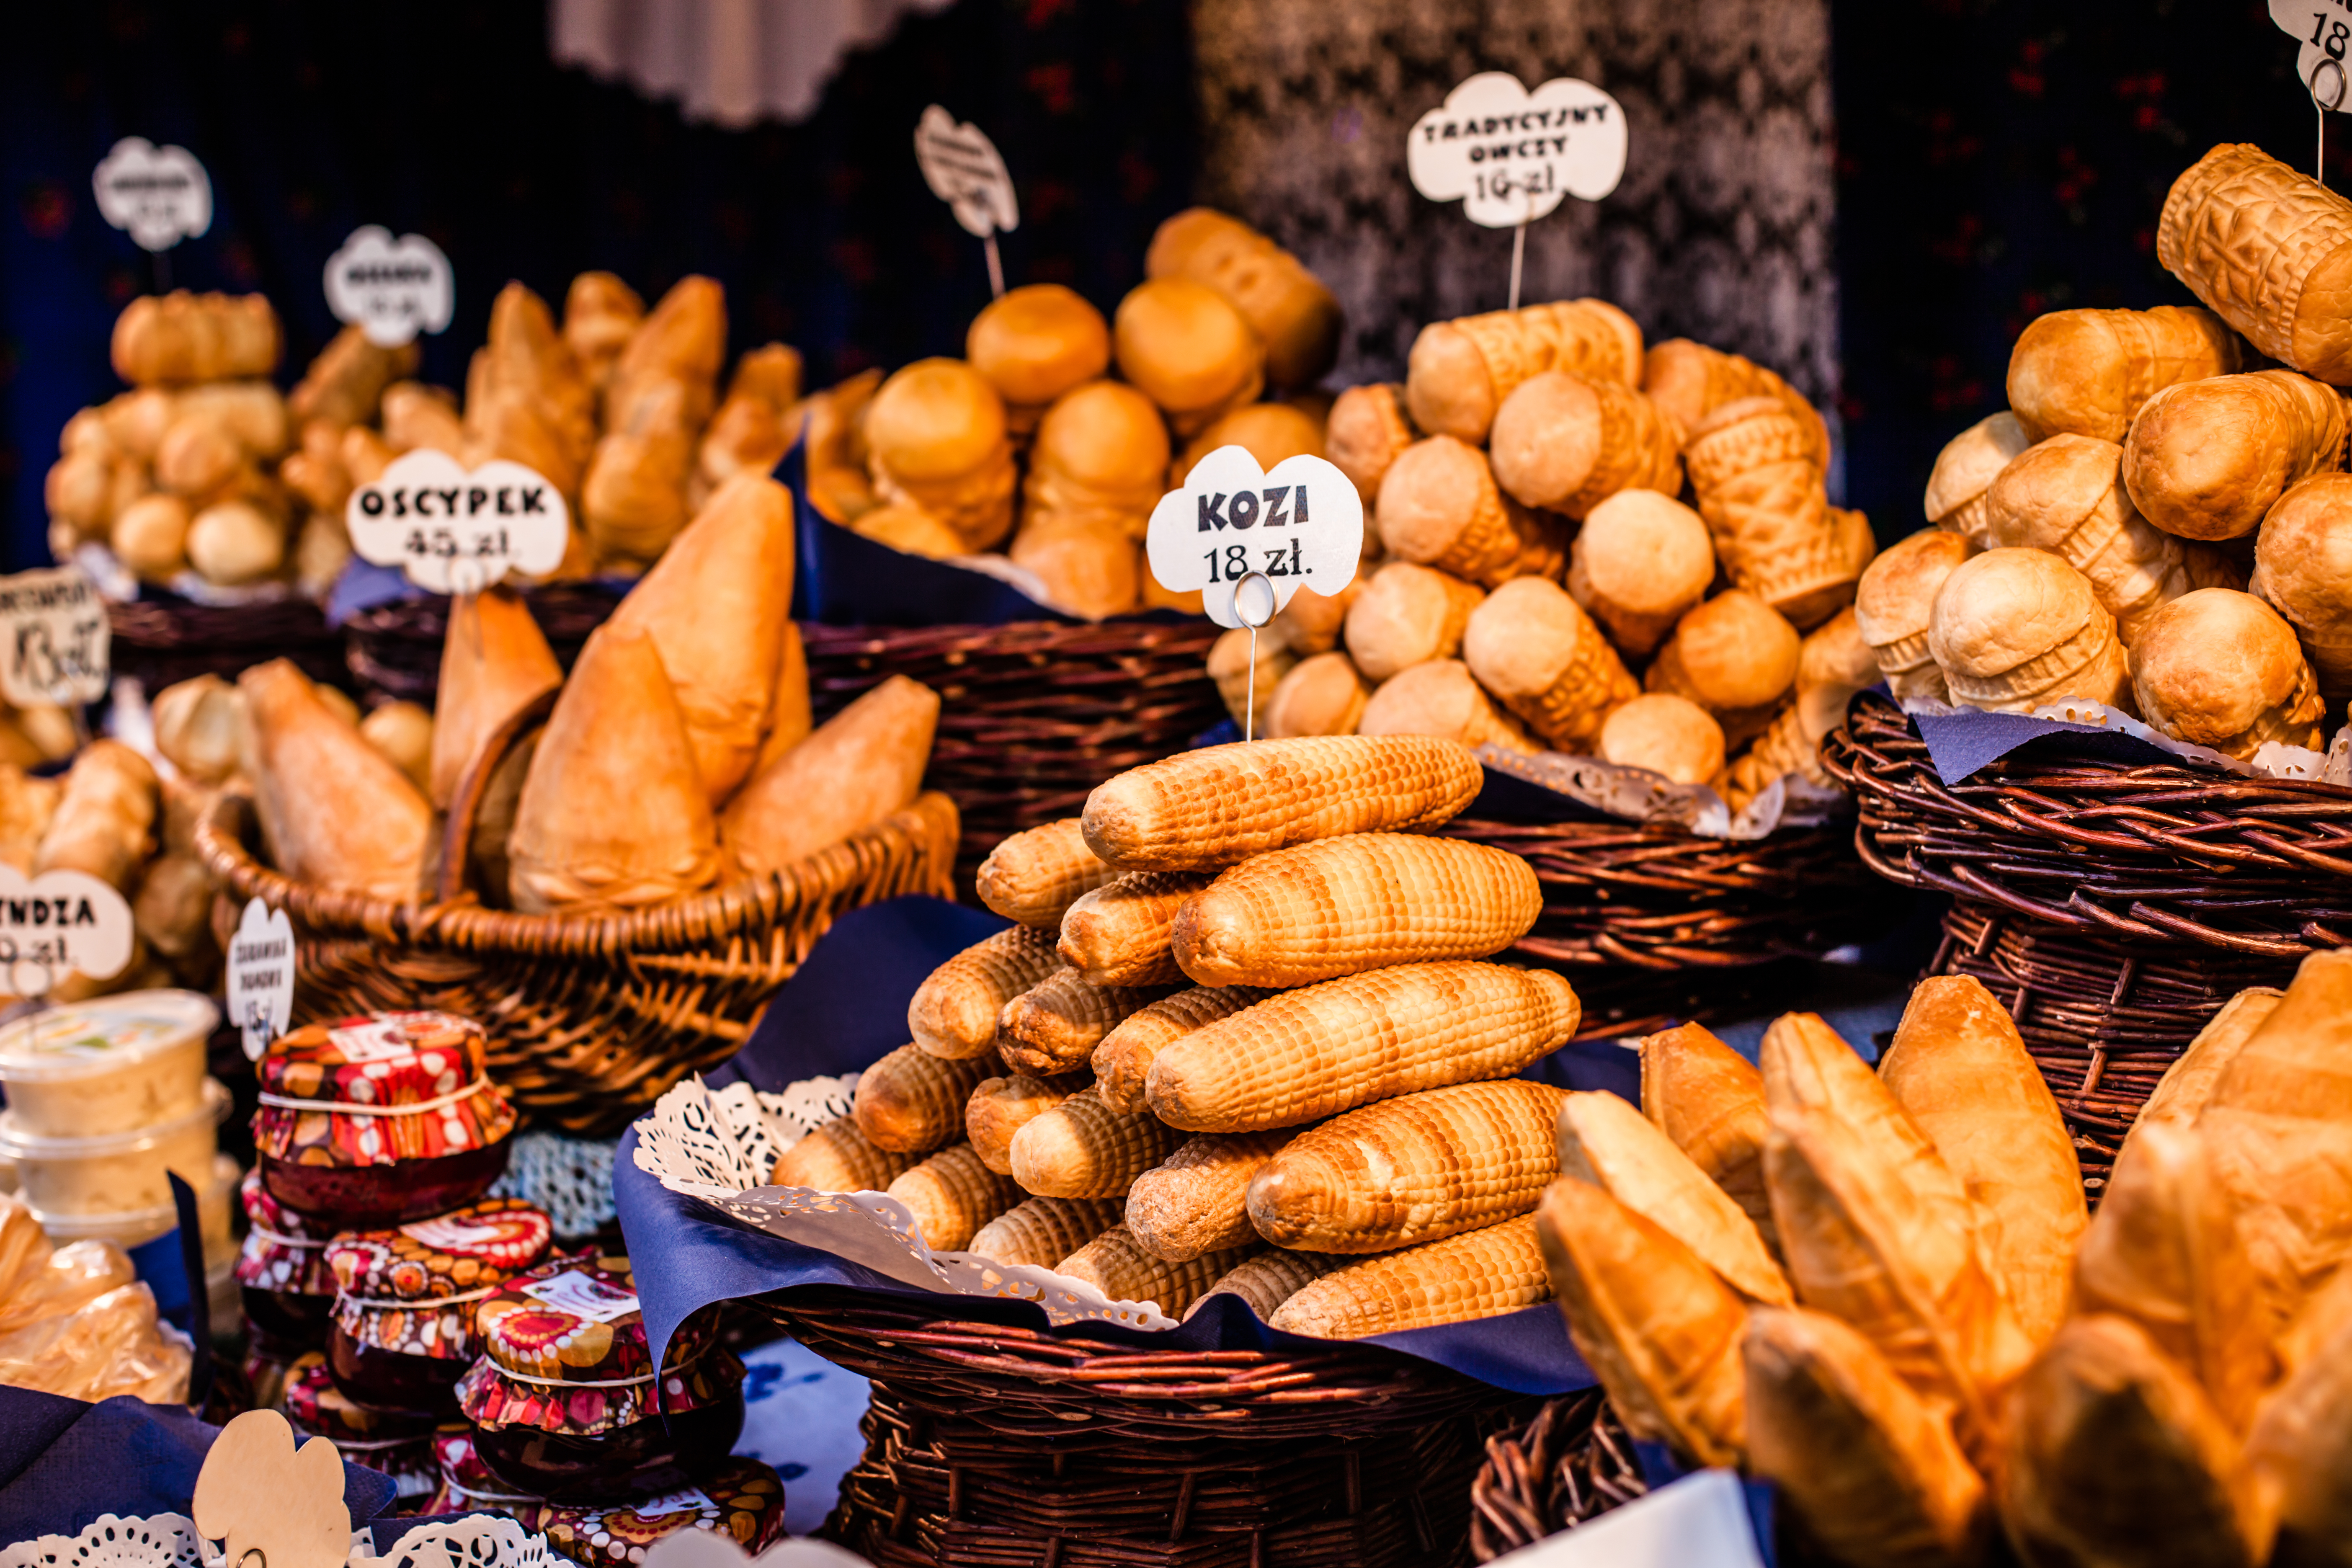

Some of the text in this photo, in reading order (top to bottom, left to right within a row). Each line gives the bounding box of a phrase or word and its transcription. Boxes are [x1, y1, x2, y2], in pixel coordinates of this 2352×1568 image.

[2310, 13, 2350, 61] 18
[1425, 104, 1608, 142] TRADYCYJNY
[1469, 137, 1567, 163] OWCZY
[361, 487, 546, 517] OSCYPEK
[1198, 485, 1309, 532] KOZI
[406, 528, 457, 557] 45
[1204, 538, 1313, 583] 18 zł.
[0, 897, 96, 925] NDZA
